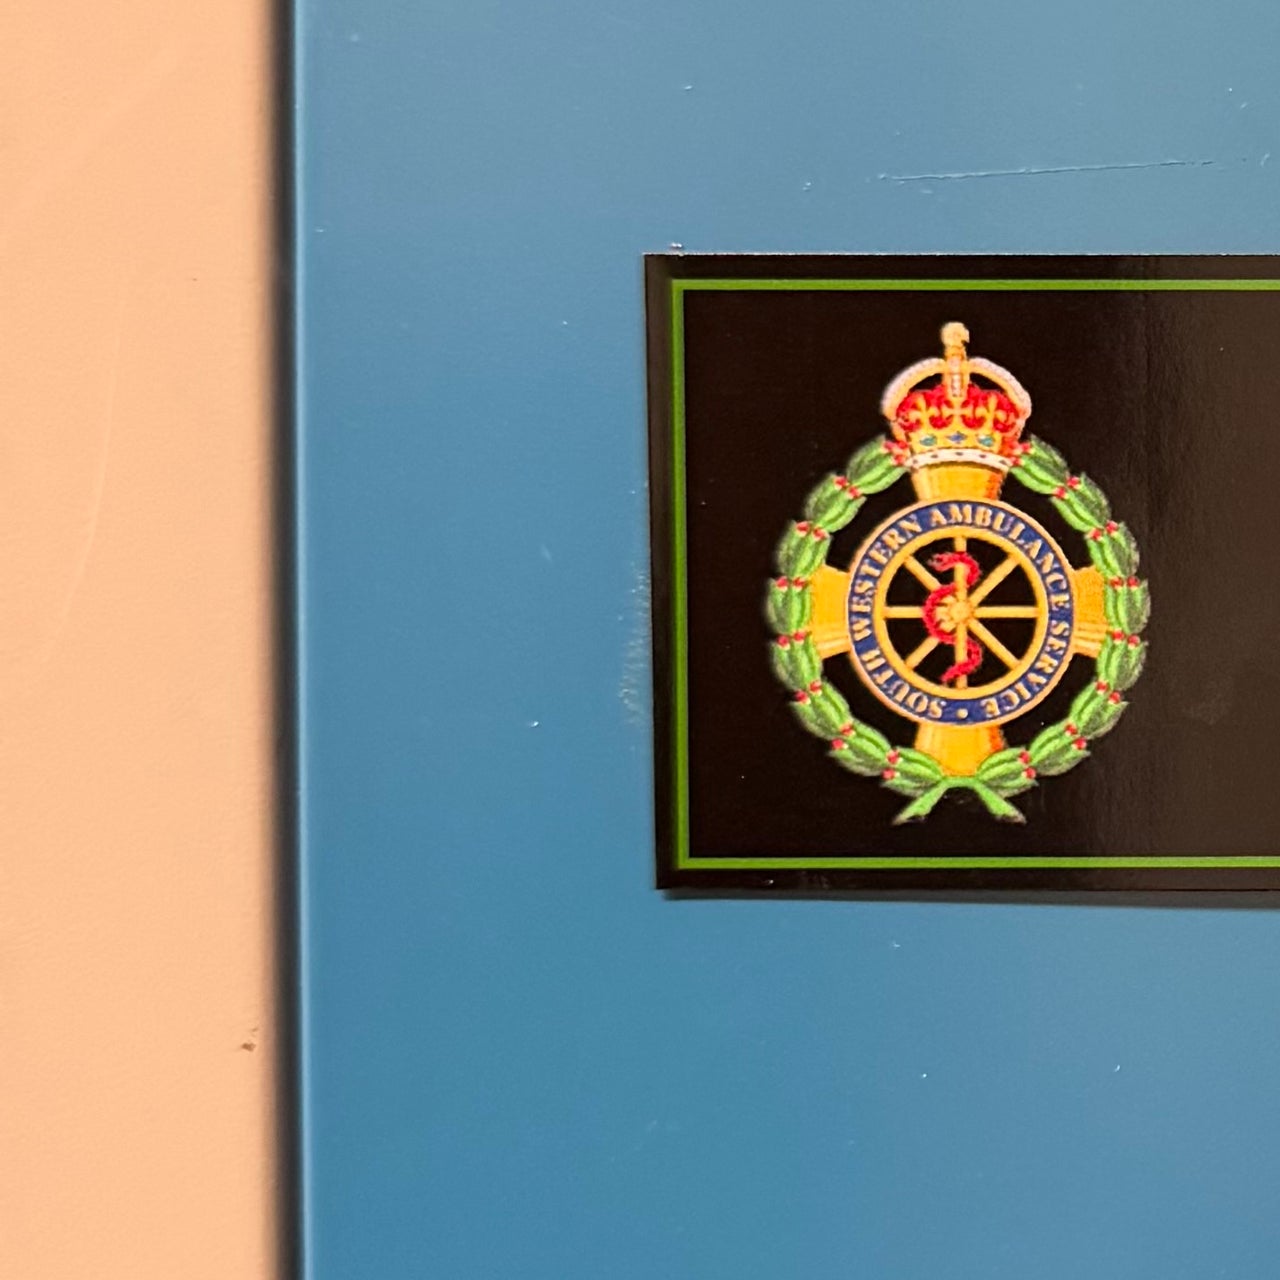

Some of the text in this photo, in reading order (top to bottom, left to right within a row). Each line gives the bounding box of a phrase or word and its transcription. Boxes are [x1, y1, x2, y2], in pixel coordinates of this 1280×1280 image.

[852, 504, 1070, 718] SOUTH WESTERN AMBULANCE SERVICE
